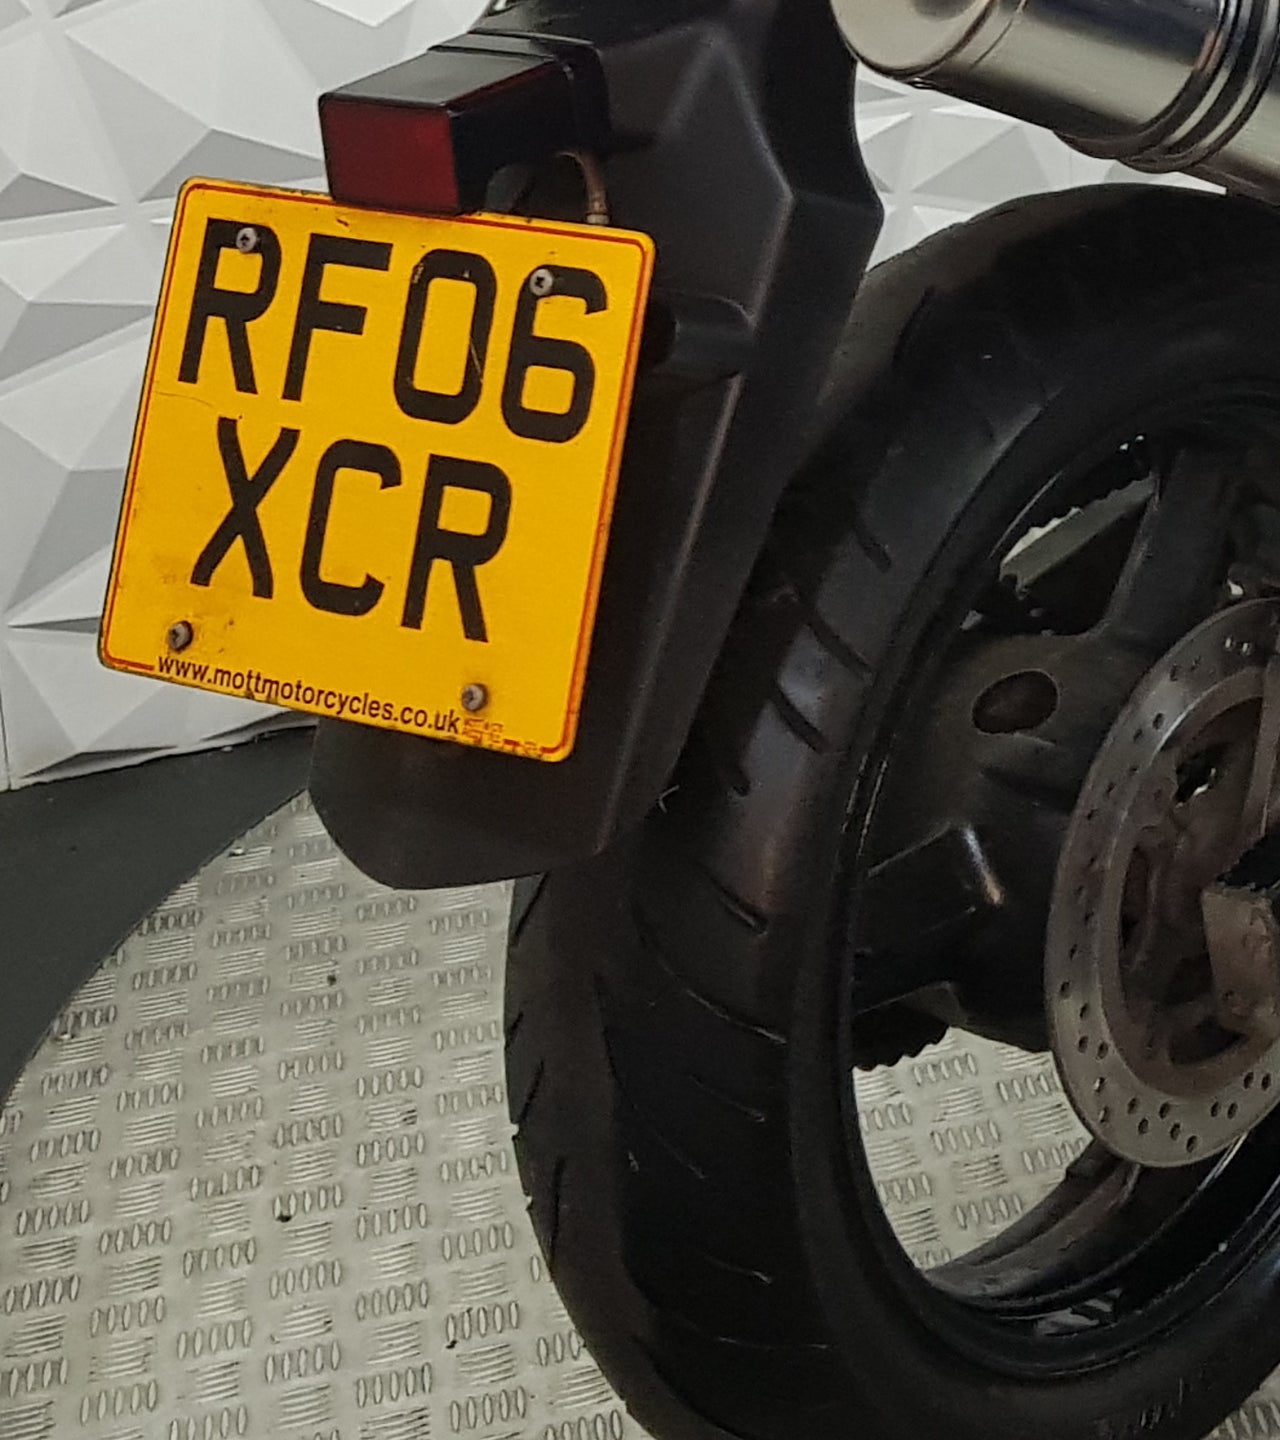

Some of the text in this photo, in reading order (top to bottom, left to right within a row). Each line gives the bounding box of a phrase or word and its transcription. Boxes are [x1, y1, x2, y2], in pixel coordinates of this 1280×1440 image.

[177, 218, 609, 444] RF06
[189, 416, 513, 643] XCR
[157, 655, 462, 735] www.mottmotorcycles.co.uk
